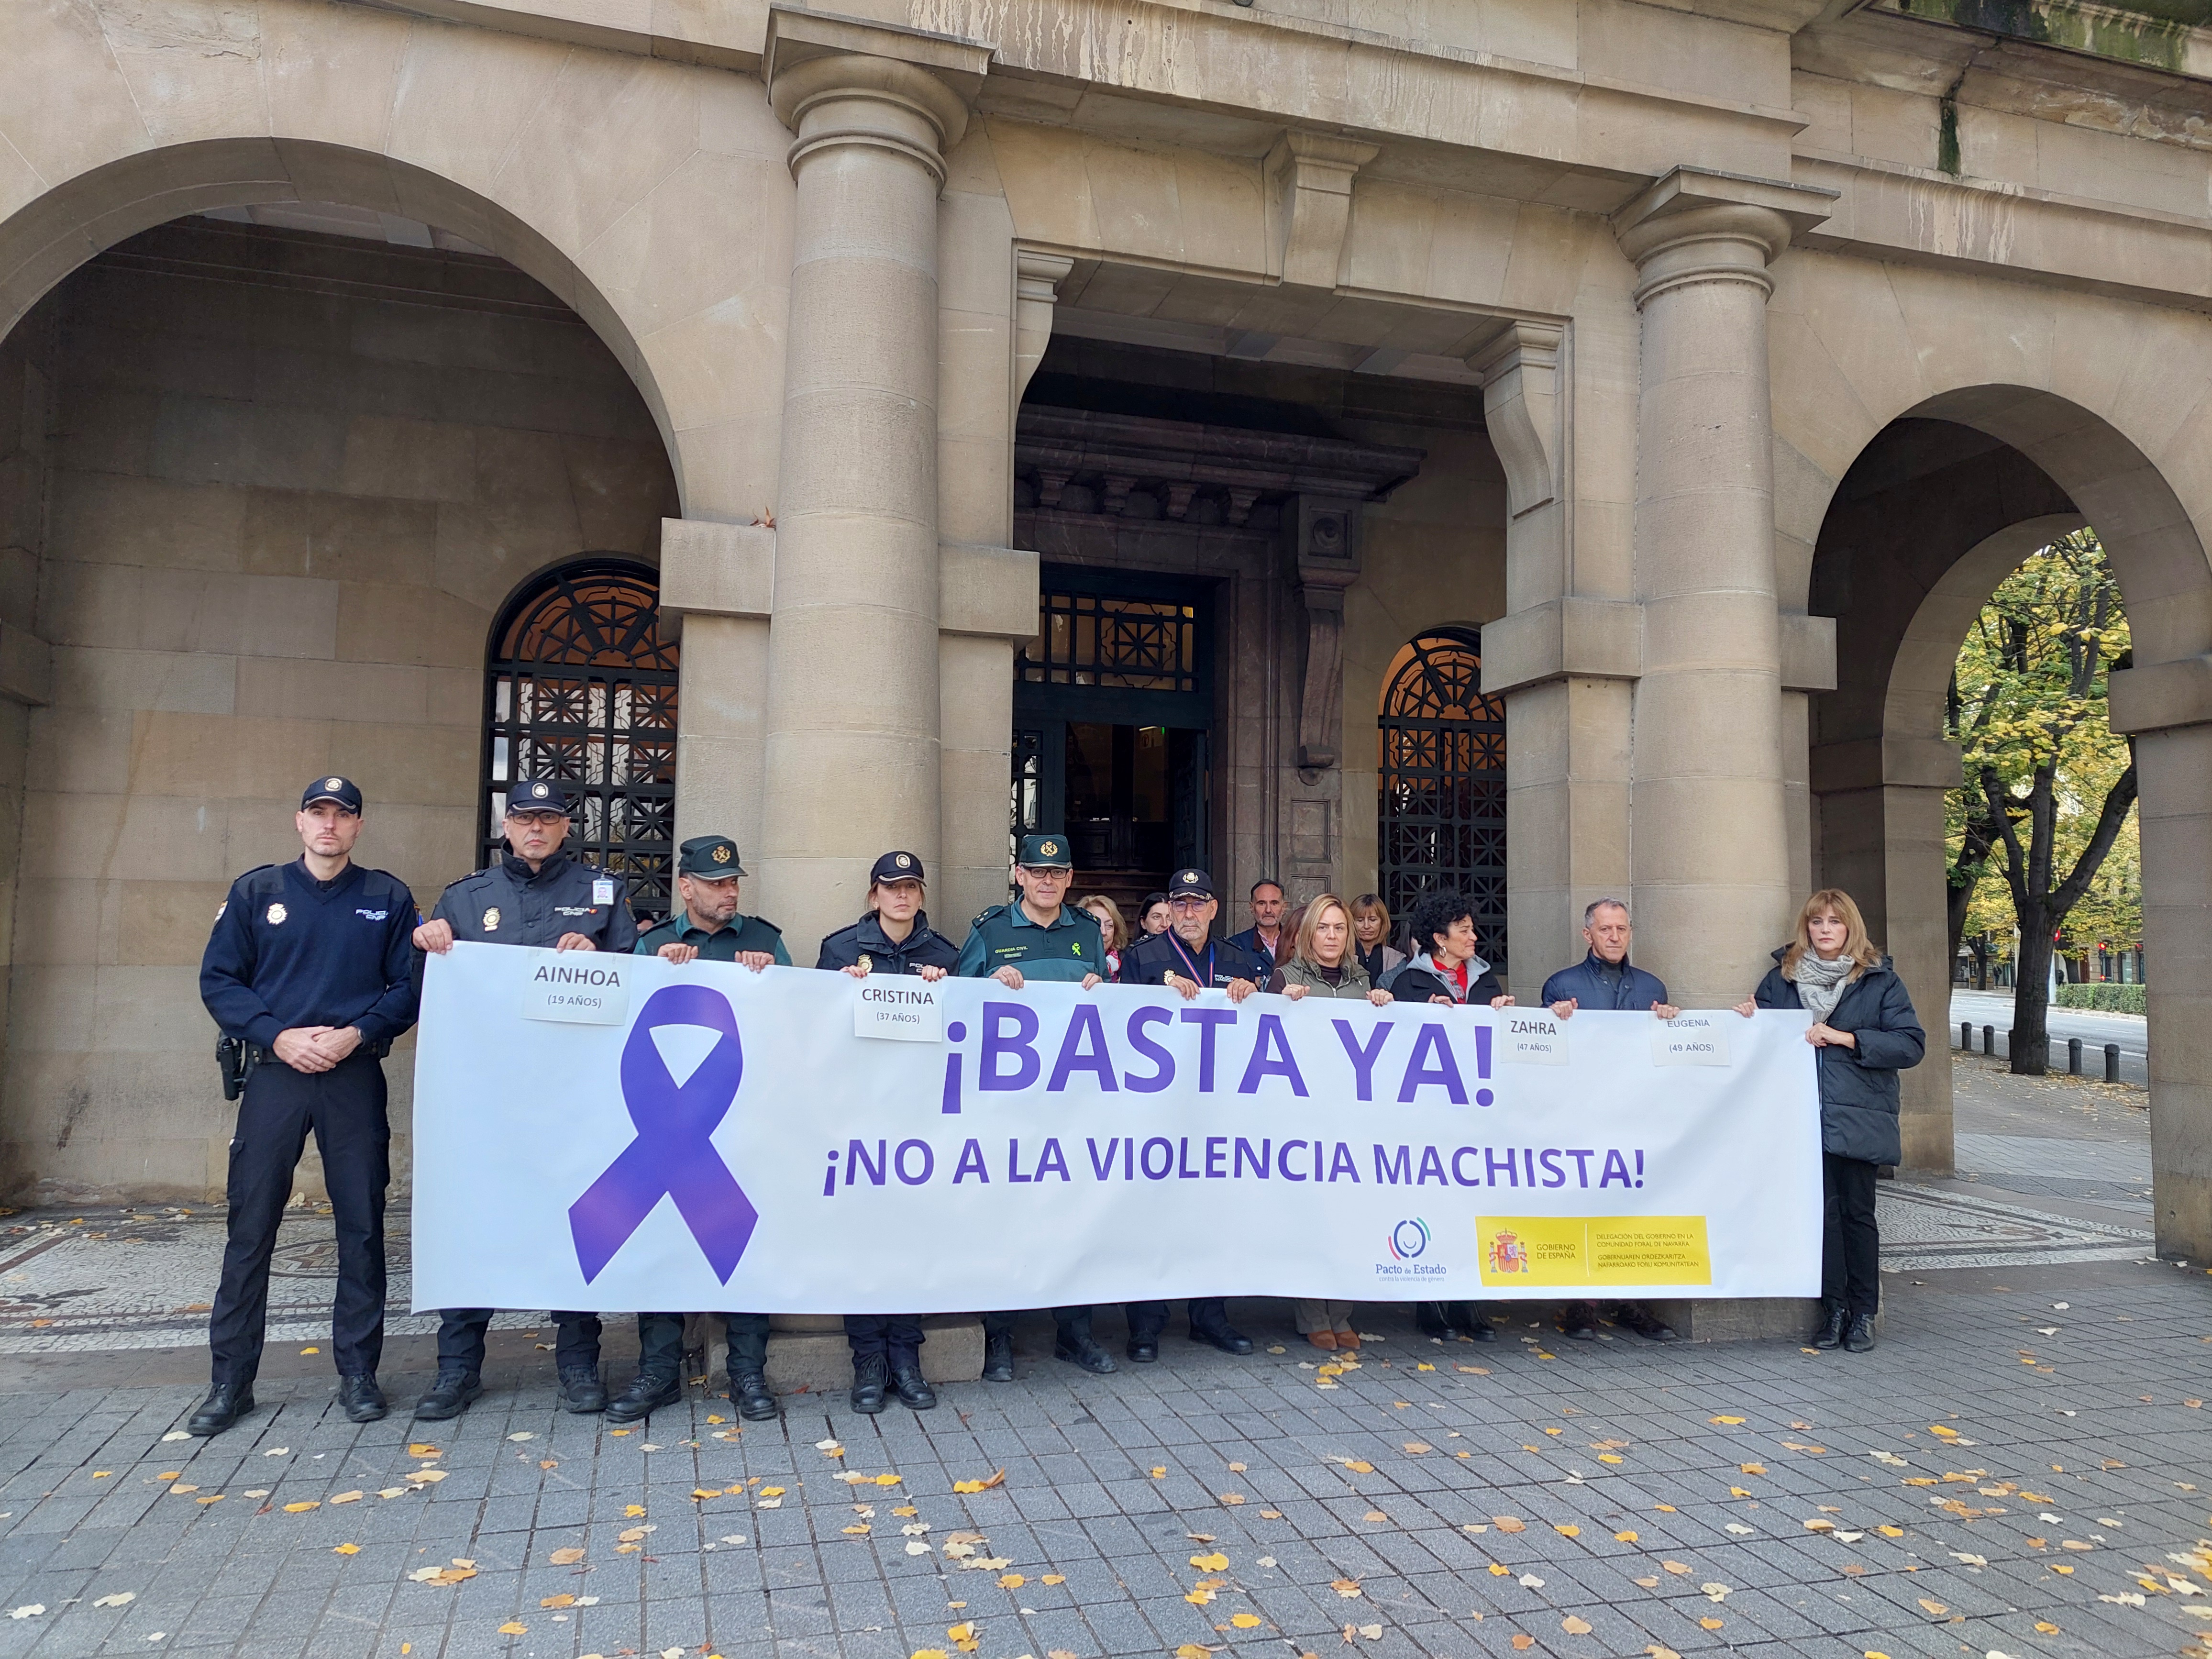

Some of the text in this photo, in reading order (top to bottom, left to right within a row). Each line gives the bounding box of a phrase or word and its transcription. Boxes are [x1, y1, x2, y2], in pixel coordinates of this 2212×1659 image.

[534, 965, 620, 987] AINHOA
[547, 994, 602, 1009] (19 AÑOS)
[862, 988, 934, 1005] CRISTINA
[876, 1011, 920, 1025] (37 AÑOS)
[1667, 1019, 1711, 1028] EUGENIA
[1510, 1020, 1557, 1036] ZAHRA
[1517, 1042, 1551, 1053] (47 AÑOS)
[1669, 1042, 1714, 1054] (49 AÑOS)
[941, 1001, 1494, 1114] ¡BASTA YA!
[823, 1136, 1644, 1196] ¡NO A LA VIOLENCIA MACHISTA!
[1548, 1251, 1576, 1259] ESPAÑA
[1376, 1264, 1402, 1274] Pacto
[1413, 1264, 1447, 1274] Estado
